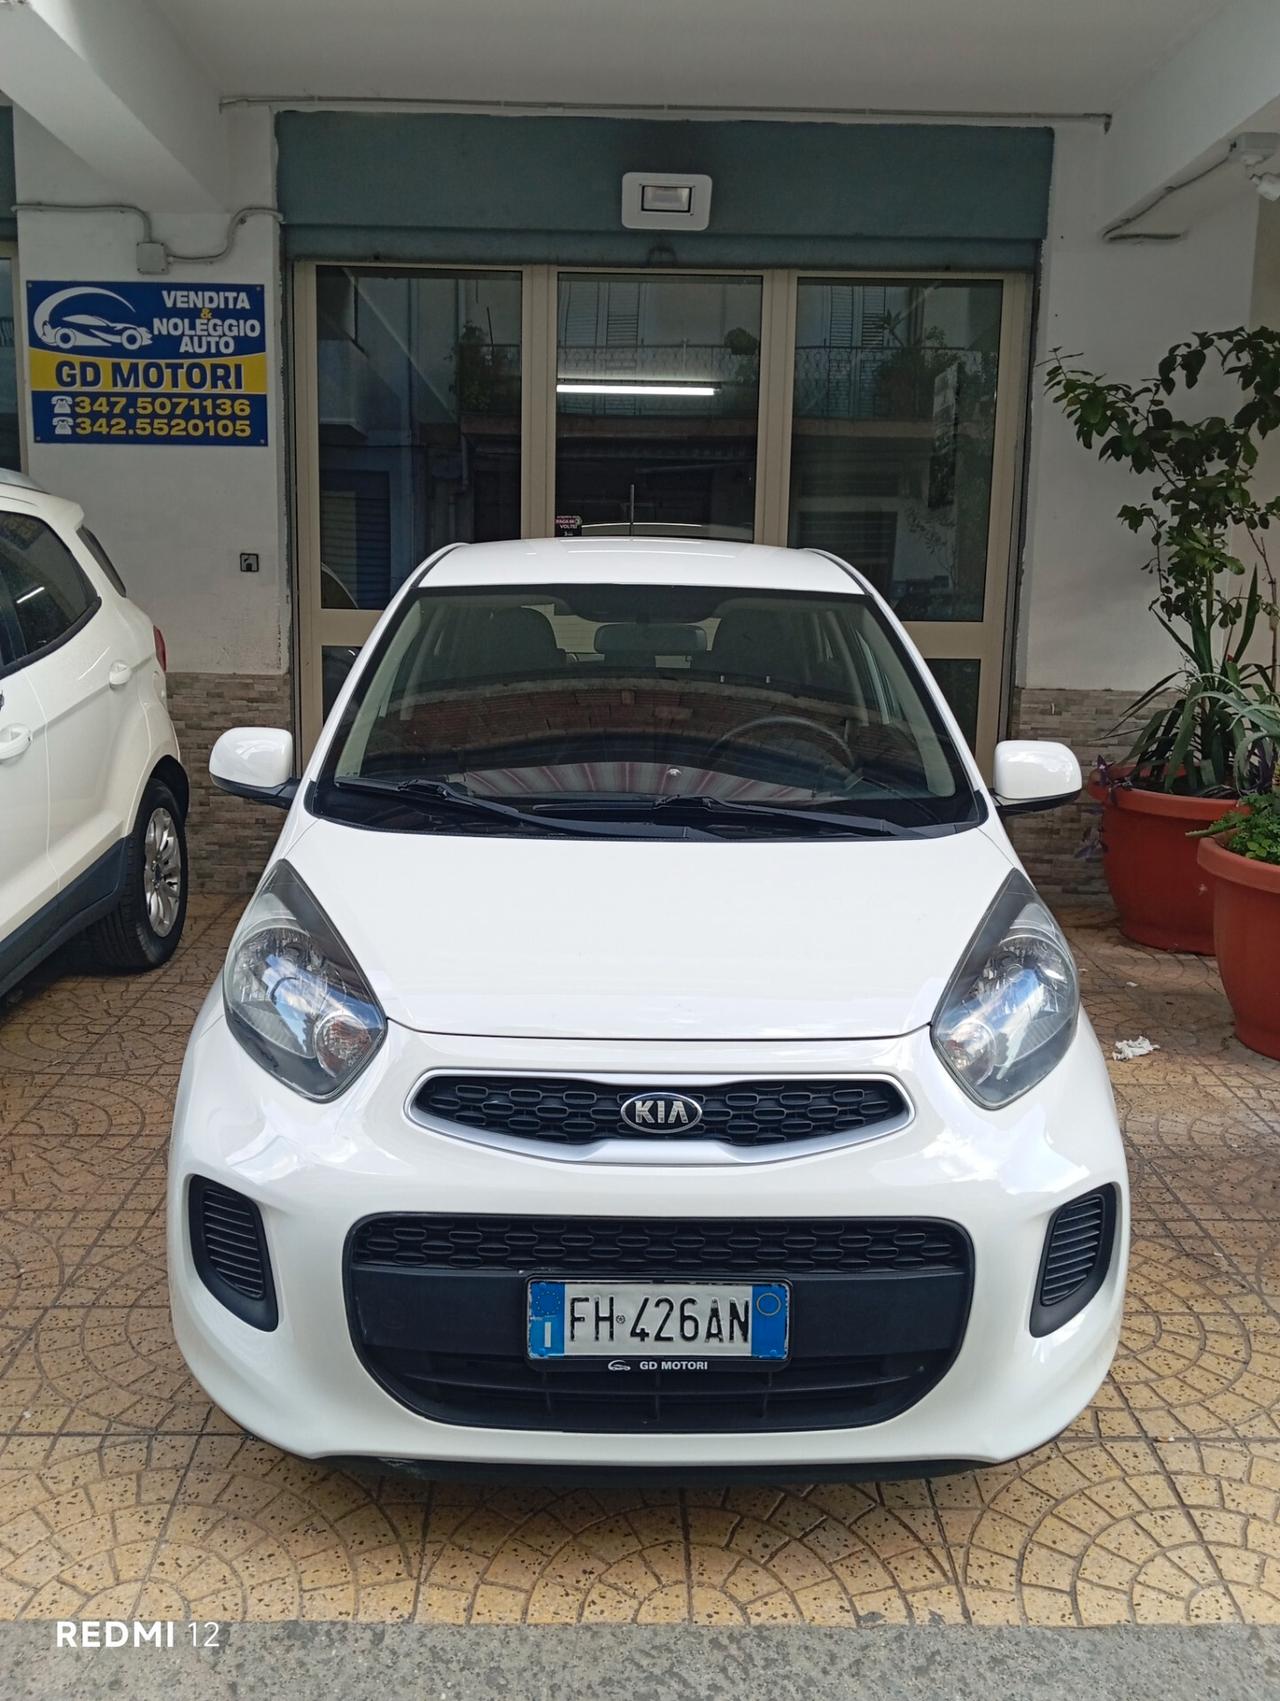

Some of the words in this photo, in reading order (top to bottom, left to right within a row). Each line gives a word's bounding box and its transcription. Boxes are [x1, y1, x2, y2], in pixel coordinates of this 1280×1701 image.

[161, 290, 251, 310] VENDITA
[201, 308, 213, 319] &
[152, 318, 261, 337] NOLEGGIO
[179, 336, 235, 354] AUTO
[55, 360, 101, 388] GD
[111, 361, 243, 390] MOTORI
[74, 396, 251, 416] 347.5071136
[75, 417, 252, 437] 342.5520105
[634, 1100, 689, 1124] KIA
[639, 1361, 658, 1370] GD
[661, 1361, 708, 1370] MOTORI
